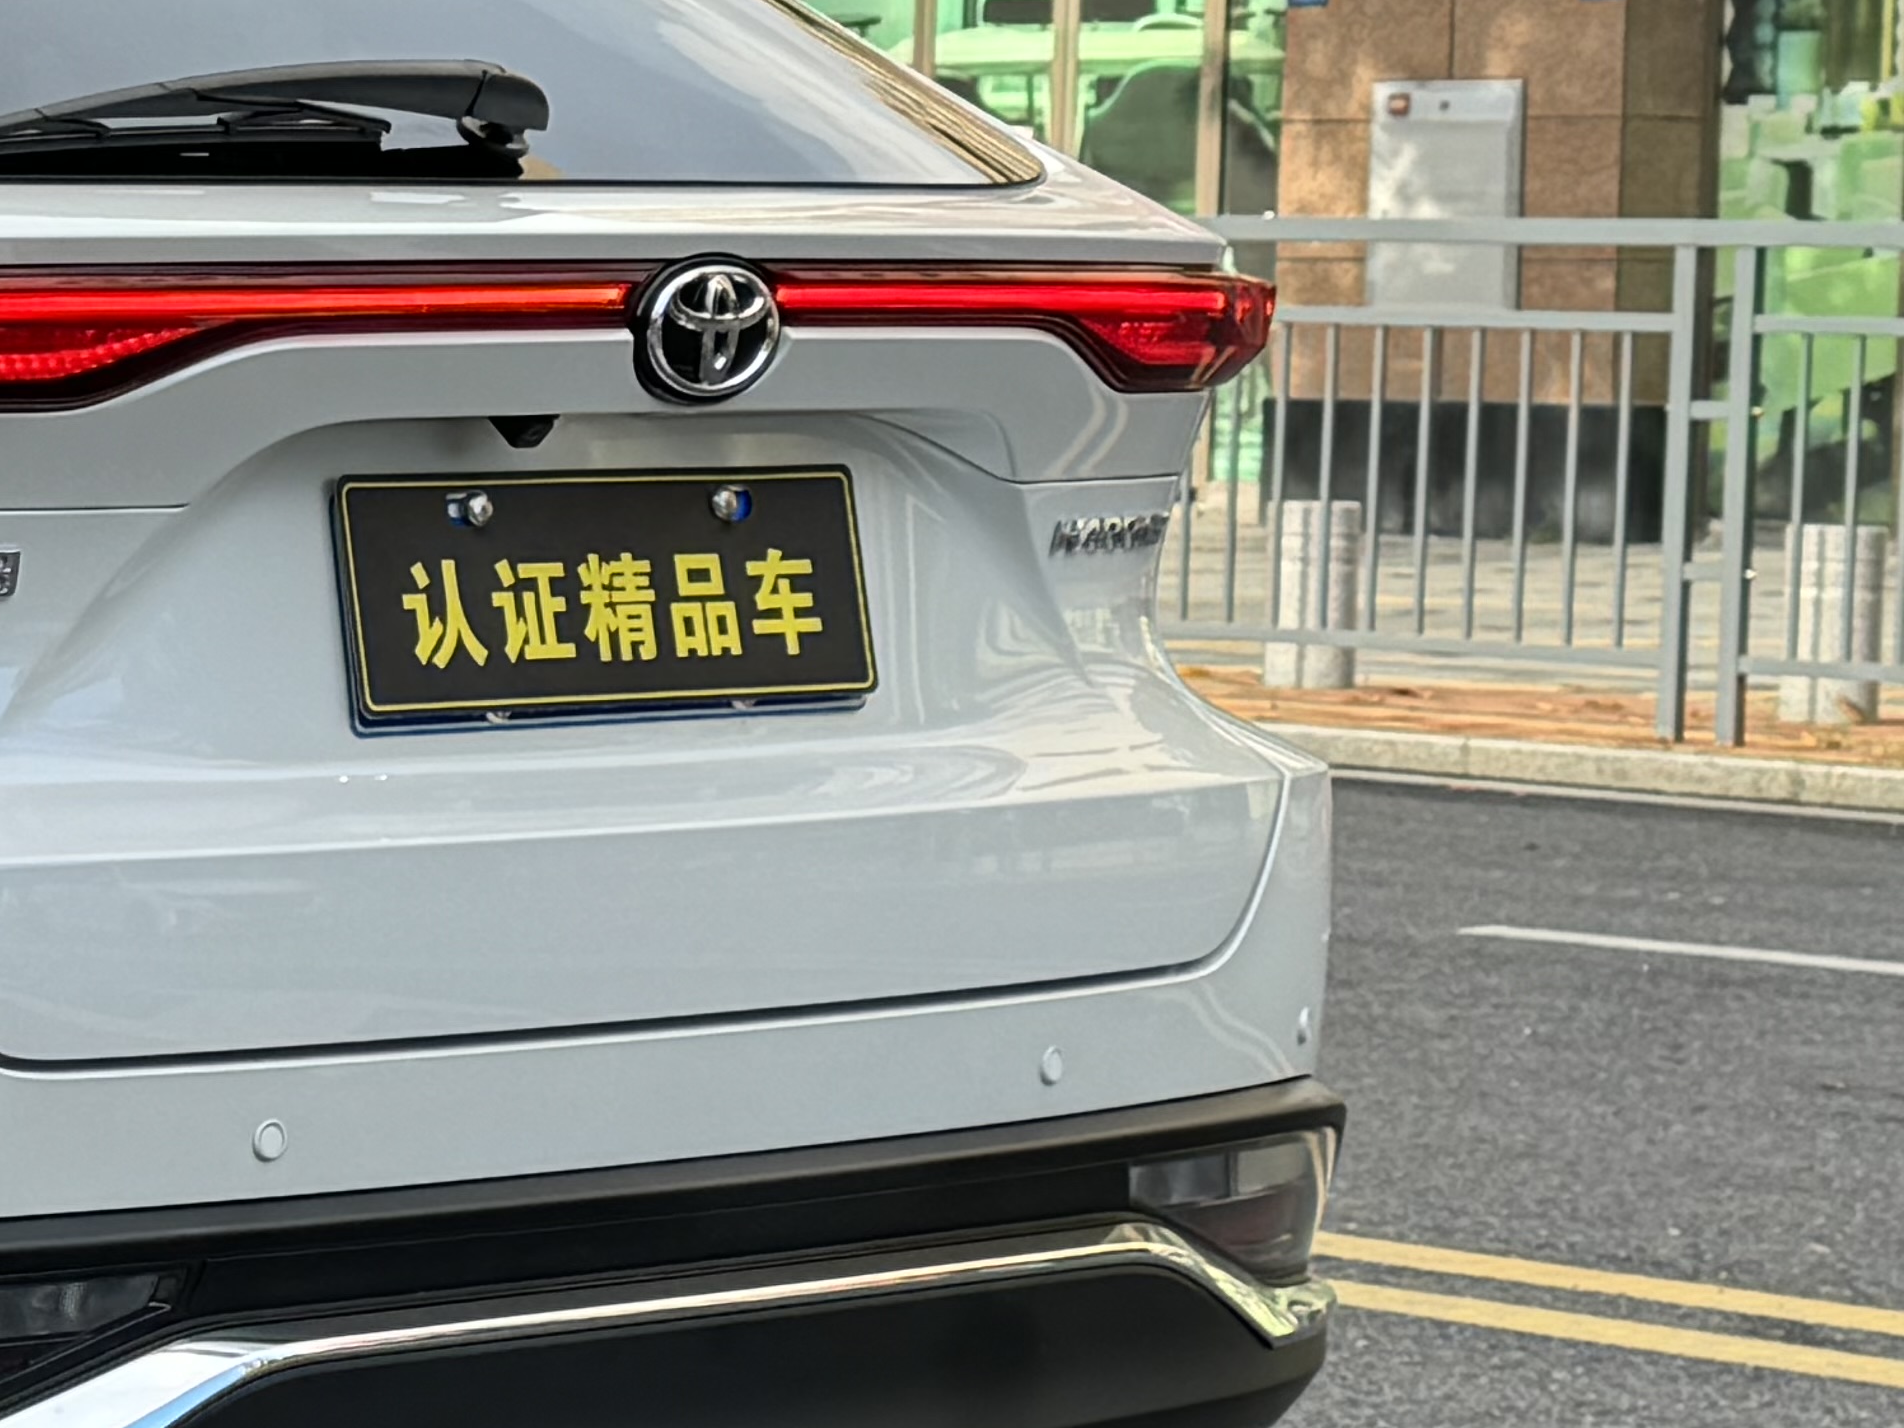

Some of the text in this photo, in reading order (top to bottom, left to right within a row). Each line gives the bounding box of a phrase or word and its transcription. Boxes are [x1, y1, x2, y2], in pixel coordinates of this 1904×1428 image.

[401, 548, 823, 669] 认证精品车
